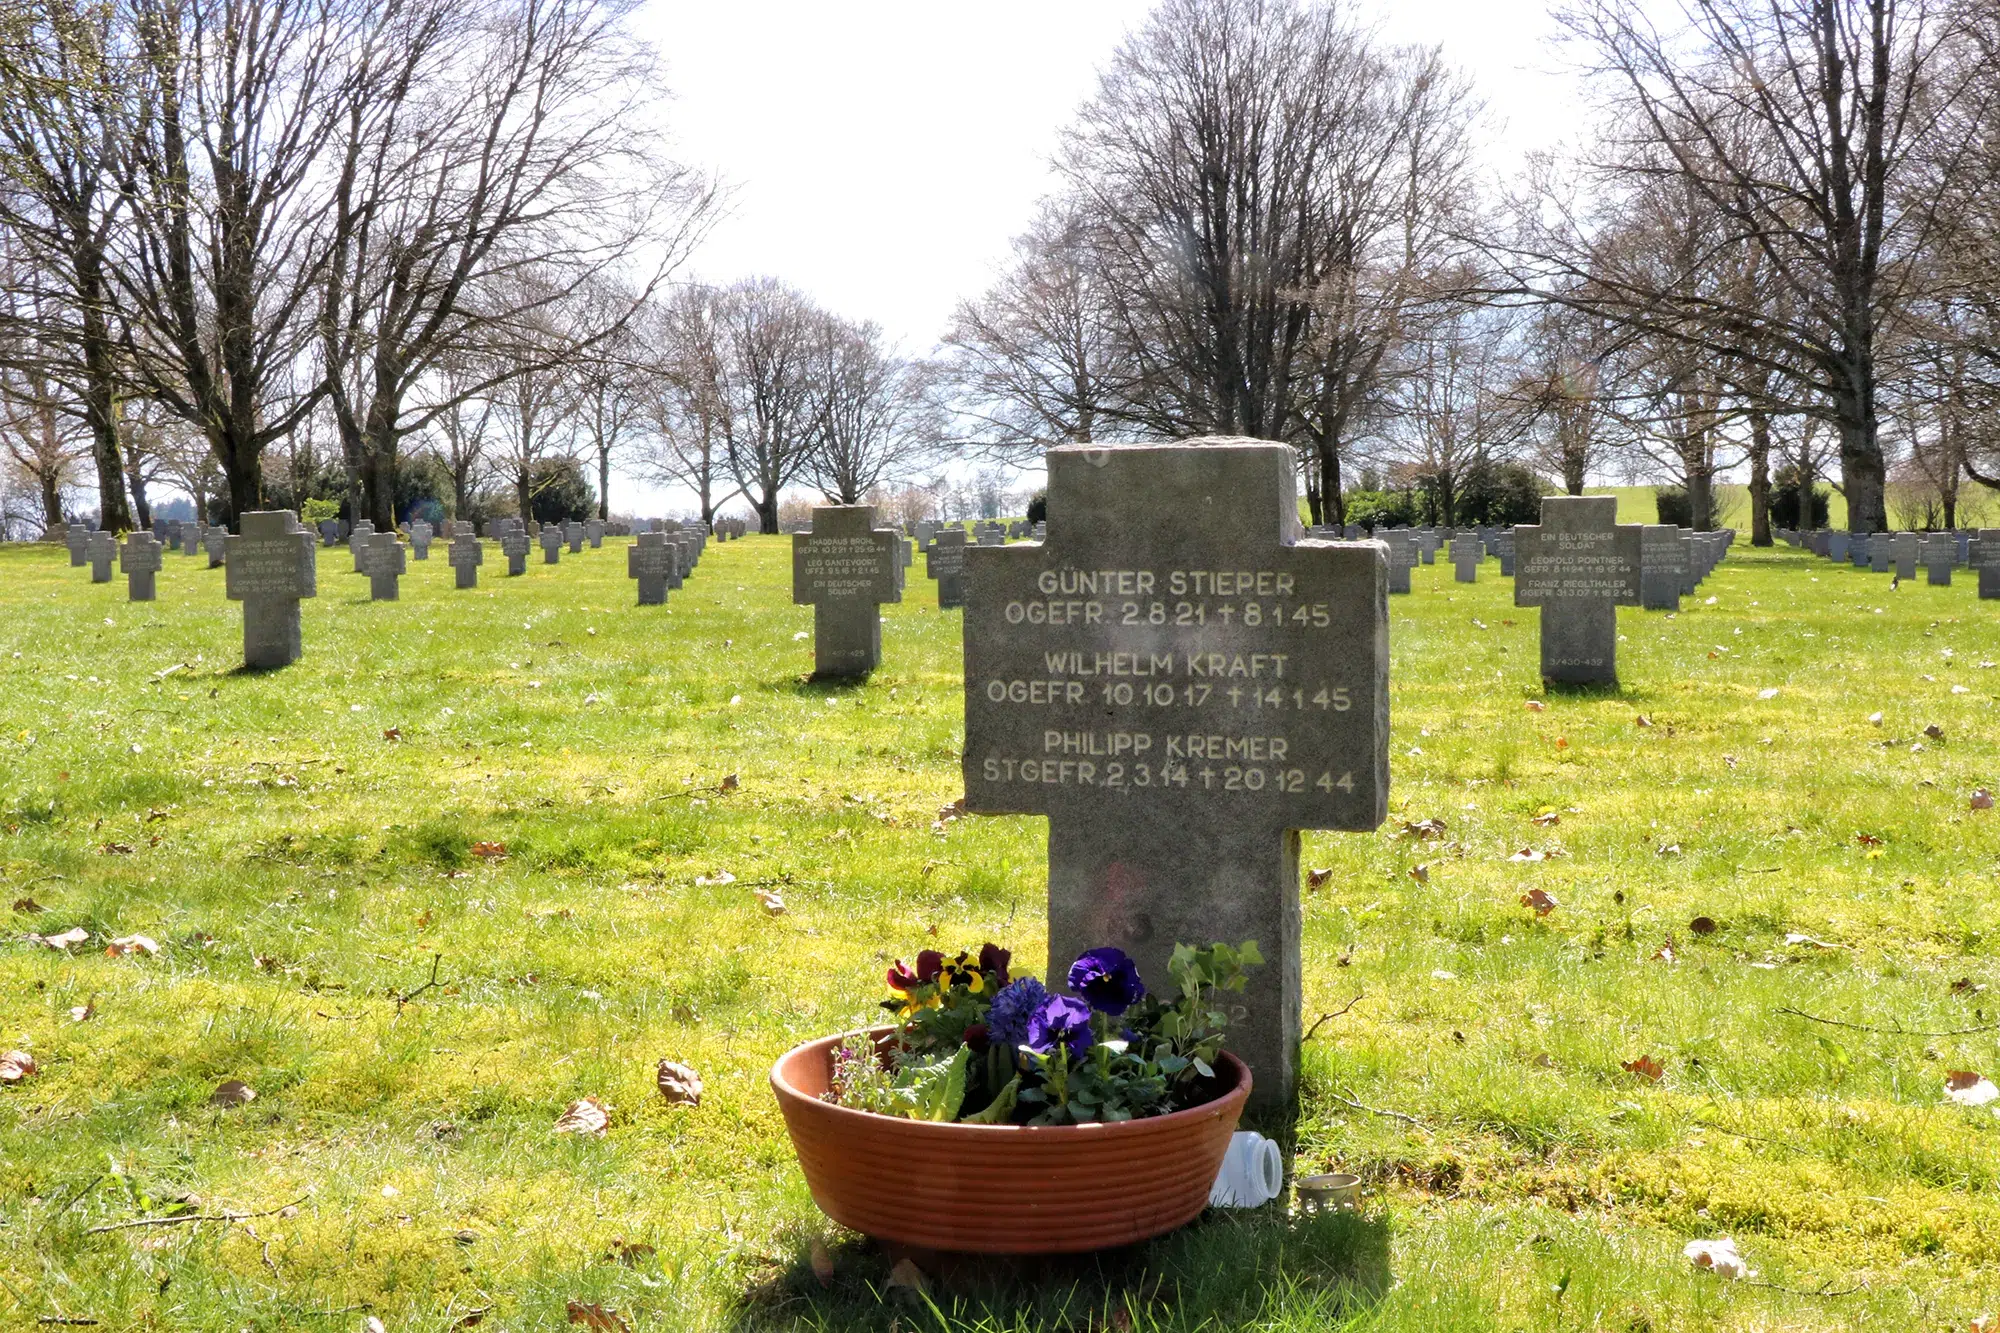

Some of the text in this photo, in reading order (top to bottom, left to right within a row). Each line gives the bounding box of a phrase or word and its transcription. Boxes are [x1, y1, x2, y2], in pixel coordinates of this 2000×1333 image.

[1541, 532, 1614, 541] EIN DEUTSCHER
[1559, 542, 1595, 550] SOLDAT
[1578, 556, 1624, 564] POINTNER
[827, 580, 872, 588] DEUTSCHER
[1038, 566, 1296, 596] GÜNTER STIEPER
[1528, 580, 1559, 588] FRANZ
[1043, 651, 1289, 679] WILHELM KRAFT
[1043, 730, 1289, 761] PHILIPP KREMER
